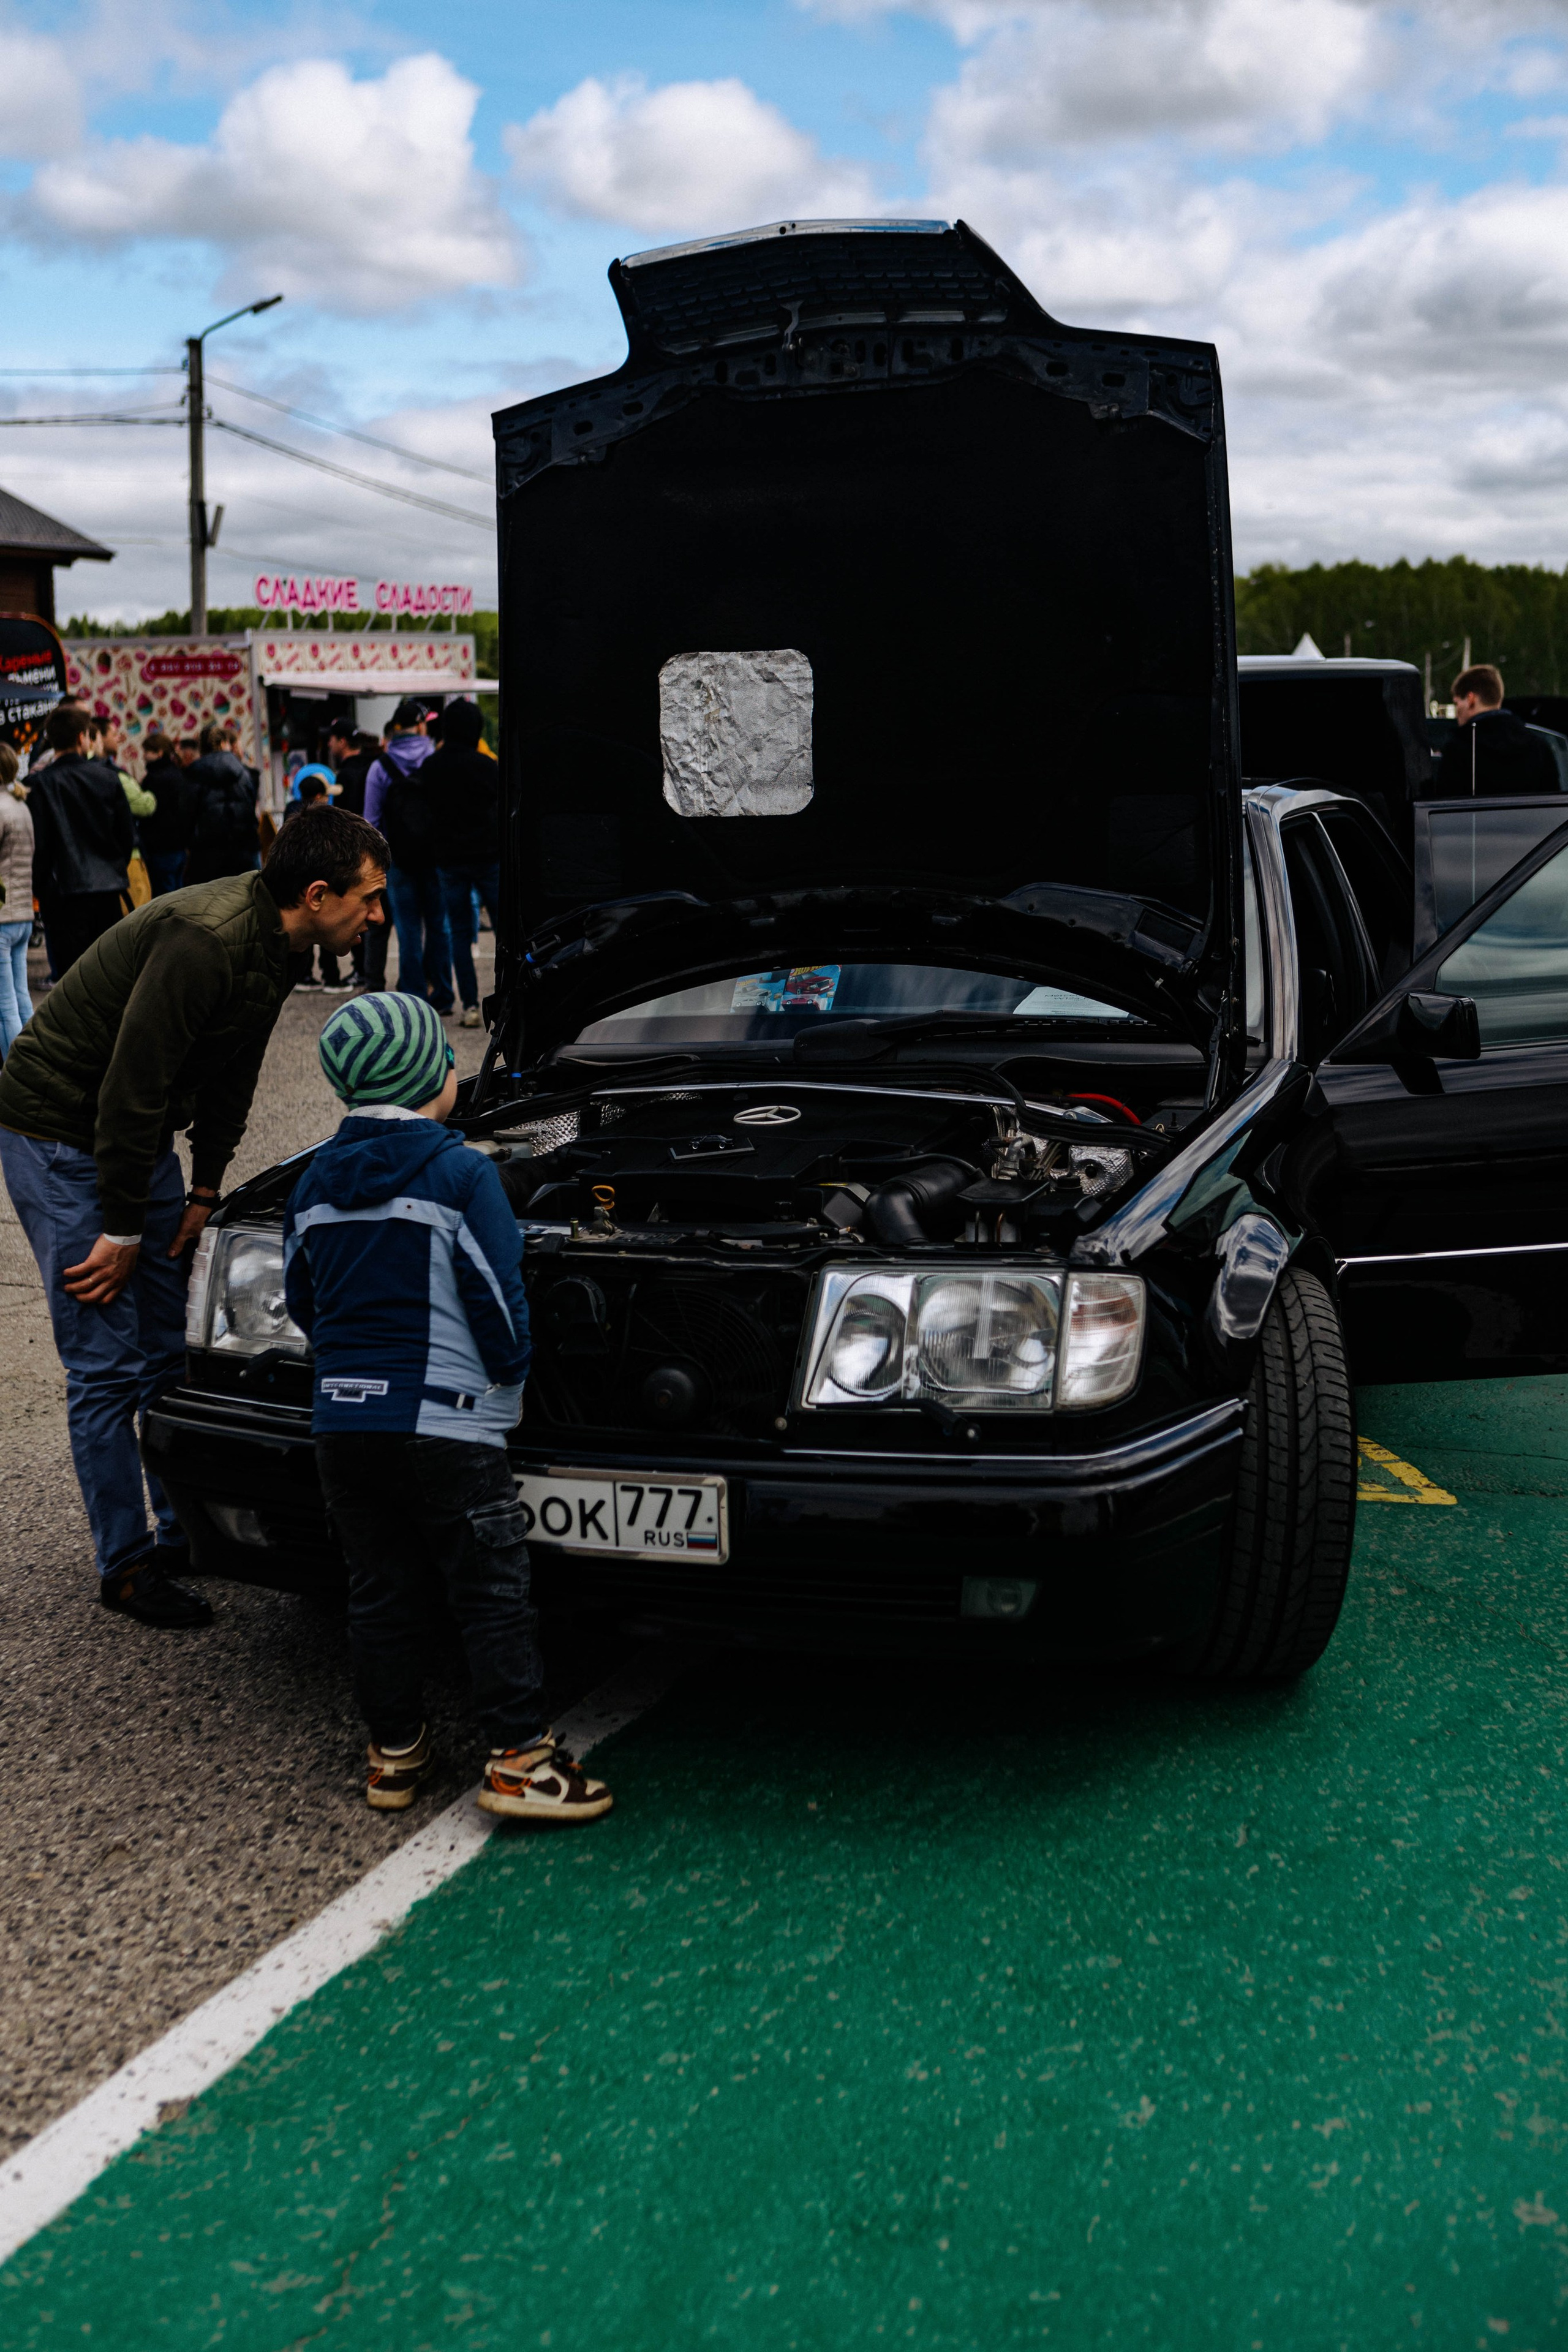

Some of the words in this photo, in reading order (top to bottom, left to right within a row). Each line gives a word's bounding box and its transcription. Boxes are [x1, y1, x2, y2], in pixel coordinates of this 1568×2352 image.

[254, 575, 360, 614] СЛАДКИЕ
[375, 580, 474, 617] СЛАДОСТИ
[620, 1485, 703, 1529] 777
[644, 1530, 685, 1548] RUS
